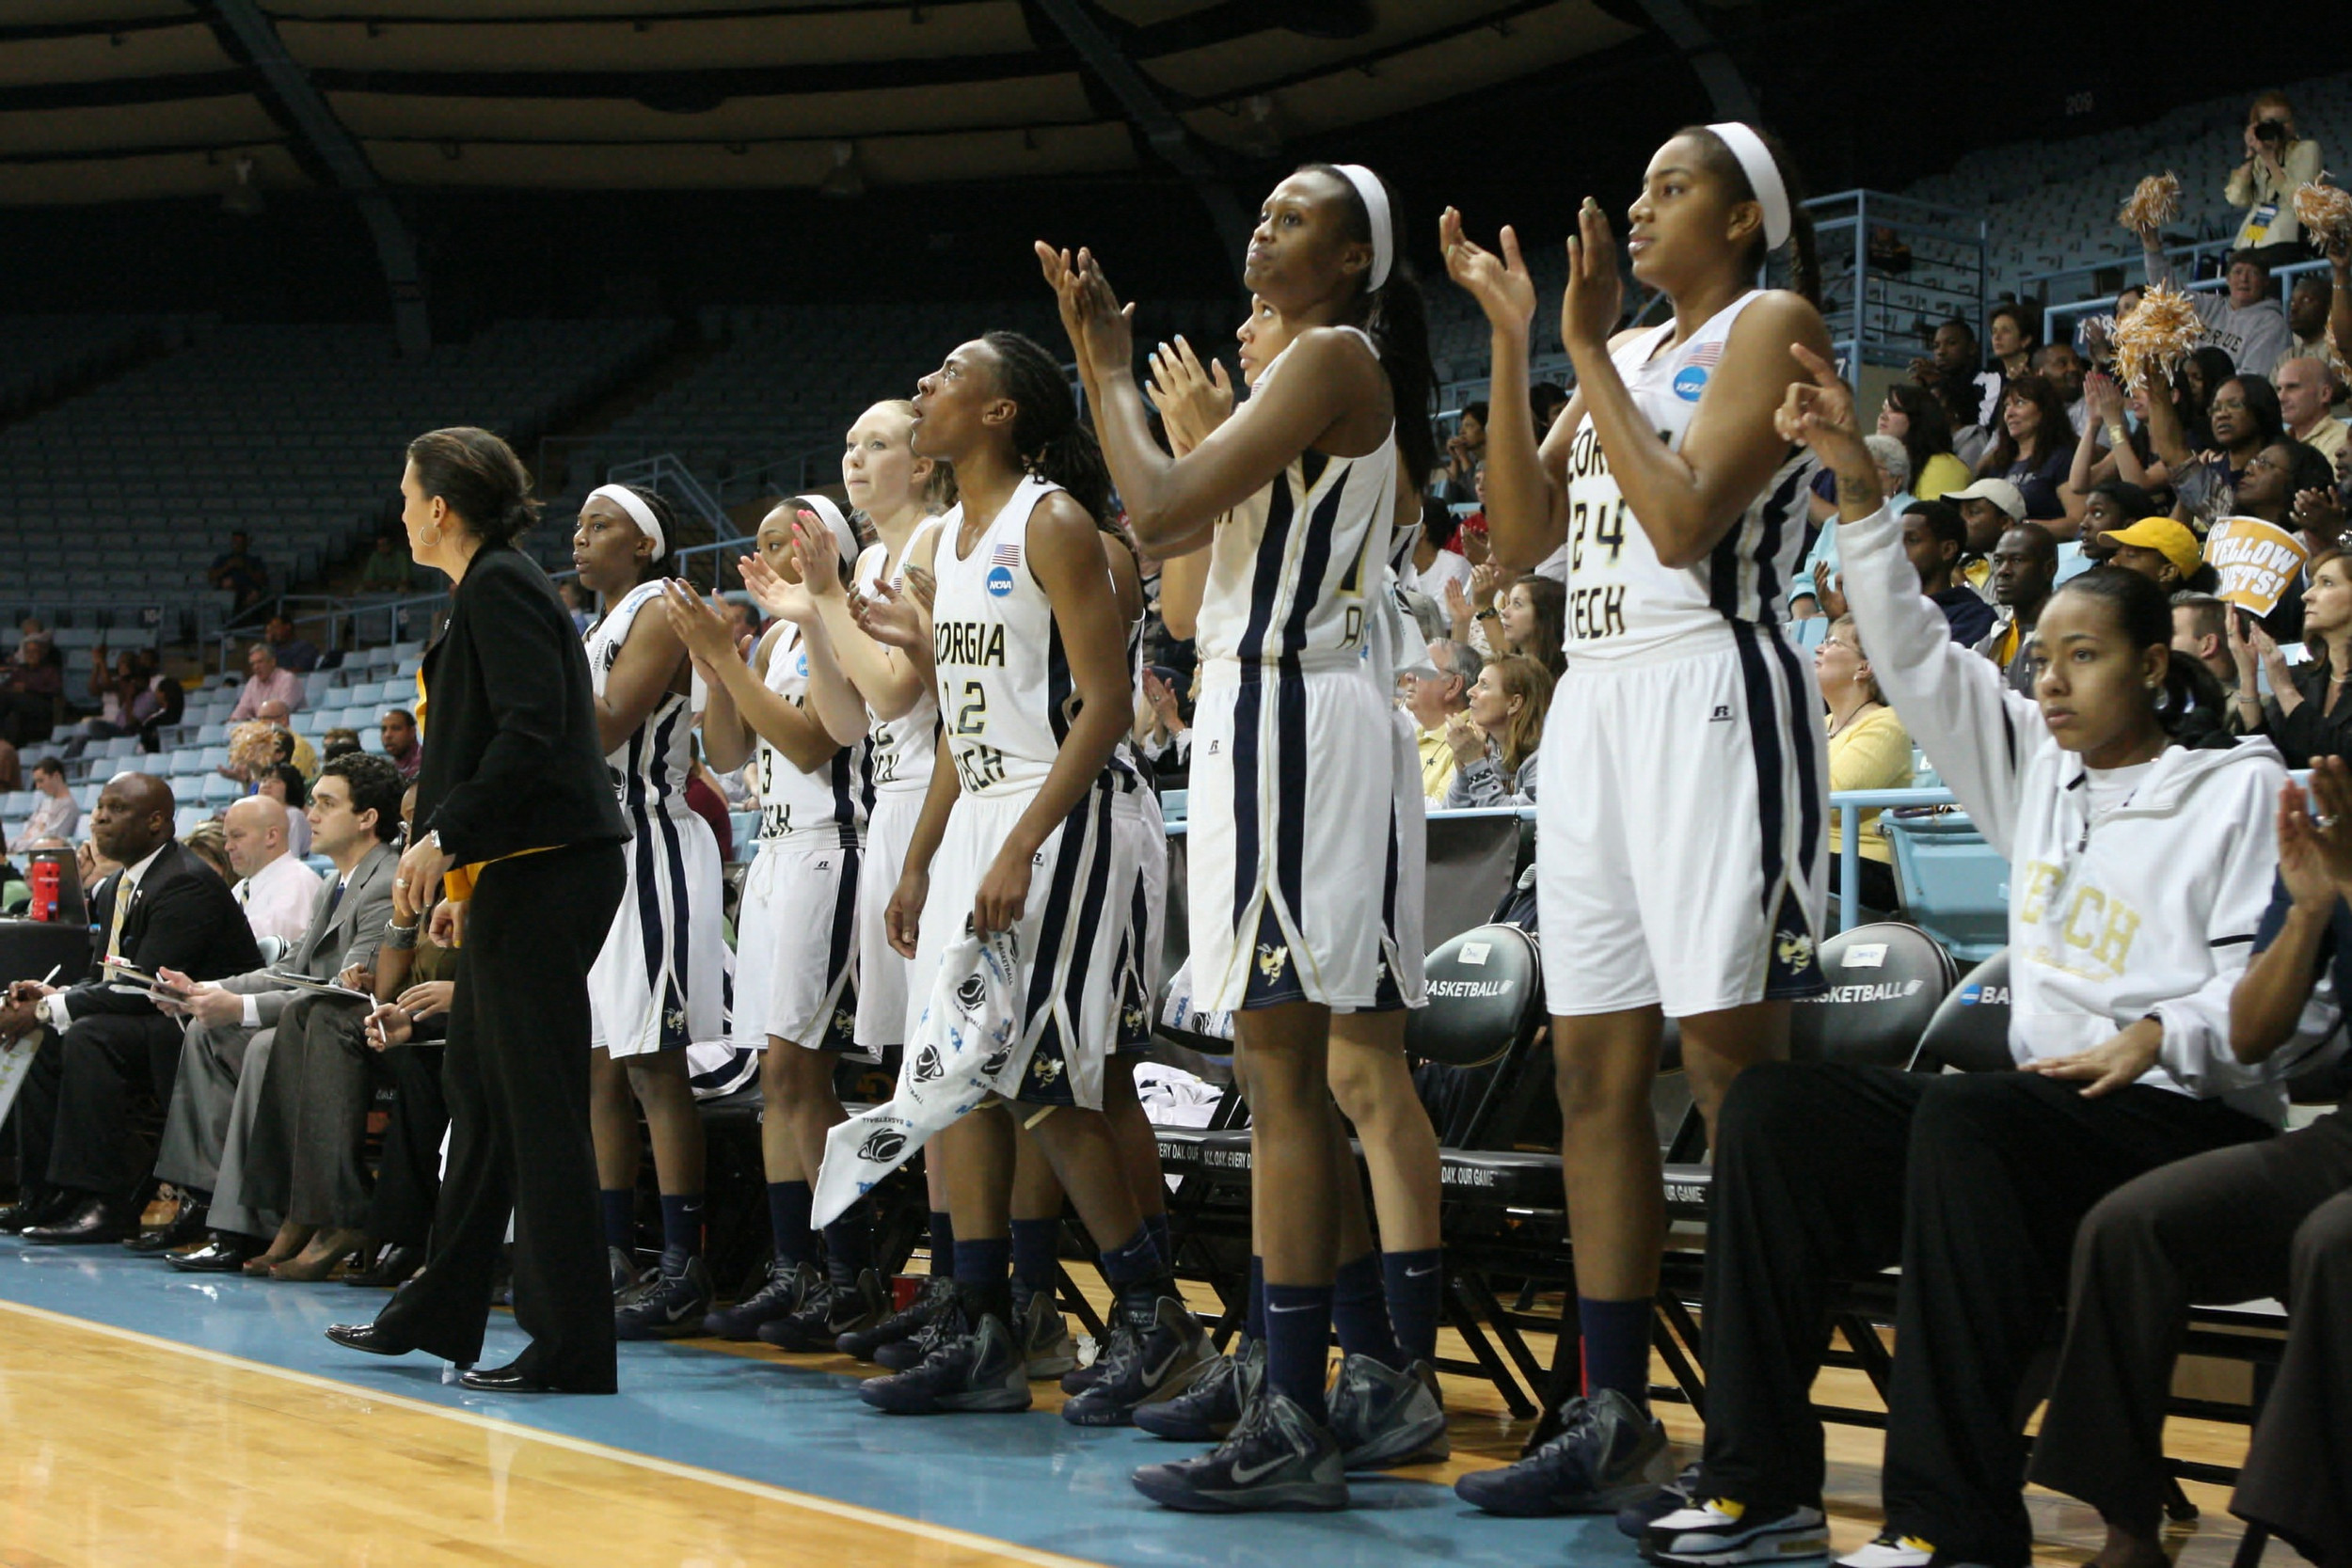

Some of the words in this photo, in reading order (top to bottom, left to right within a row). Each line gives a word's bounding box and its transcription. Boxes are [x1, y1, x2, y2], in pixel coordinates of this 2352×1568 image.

[1572, 499, 1627, 571] 24
[2211, 537, 2299, 575] YELLOW
[989, 580, 1013, 591] NCAA
[996, 941, 1014, 986] BASKETBALL
[1793, 983, 1902, 1004] SKETBALL
[1457, 1167, 1473, 1185] OUR
[1677, 1185, 1706, 1203] GAME
